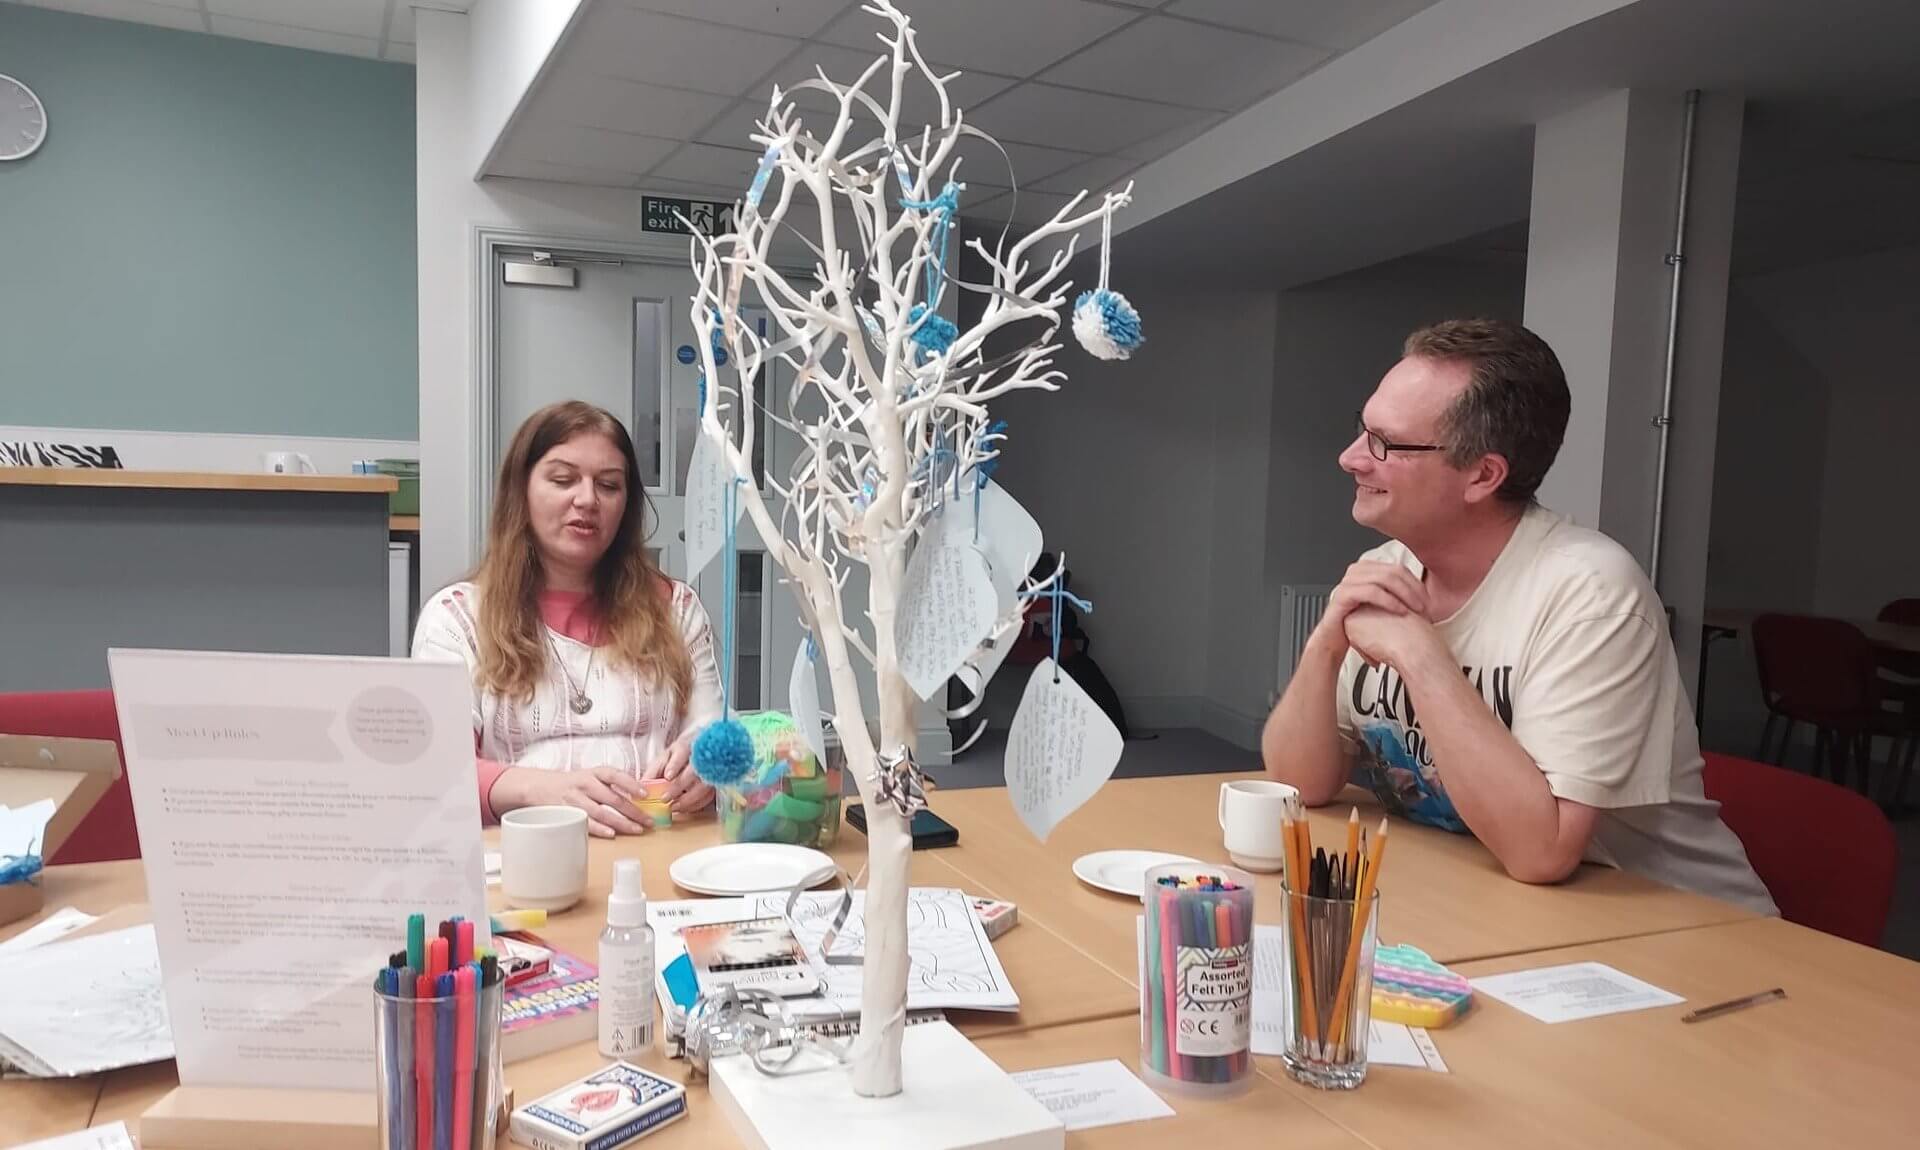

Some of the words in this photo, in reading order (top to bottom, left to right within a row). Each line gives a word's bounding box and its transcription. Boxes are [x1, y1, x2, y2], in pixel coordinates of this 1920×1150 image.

[648, 201, 680, 214] Fire
[648, 218, 680, 230] exit
[1201, 966, 1246, 982] Assorted
[1192, 983, 1214, 995] Felt
[1217, 983, 1235, 996] Tip
